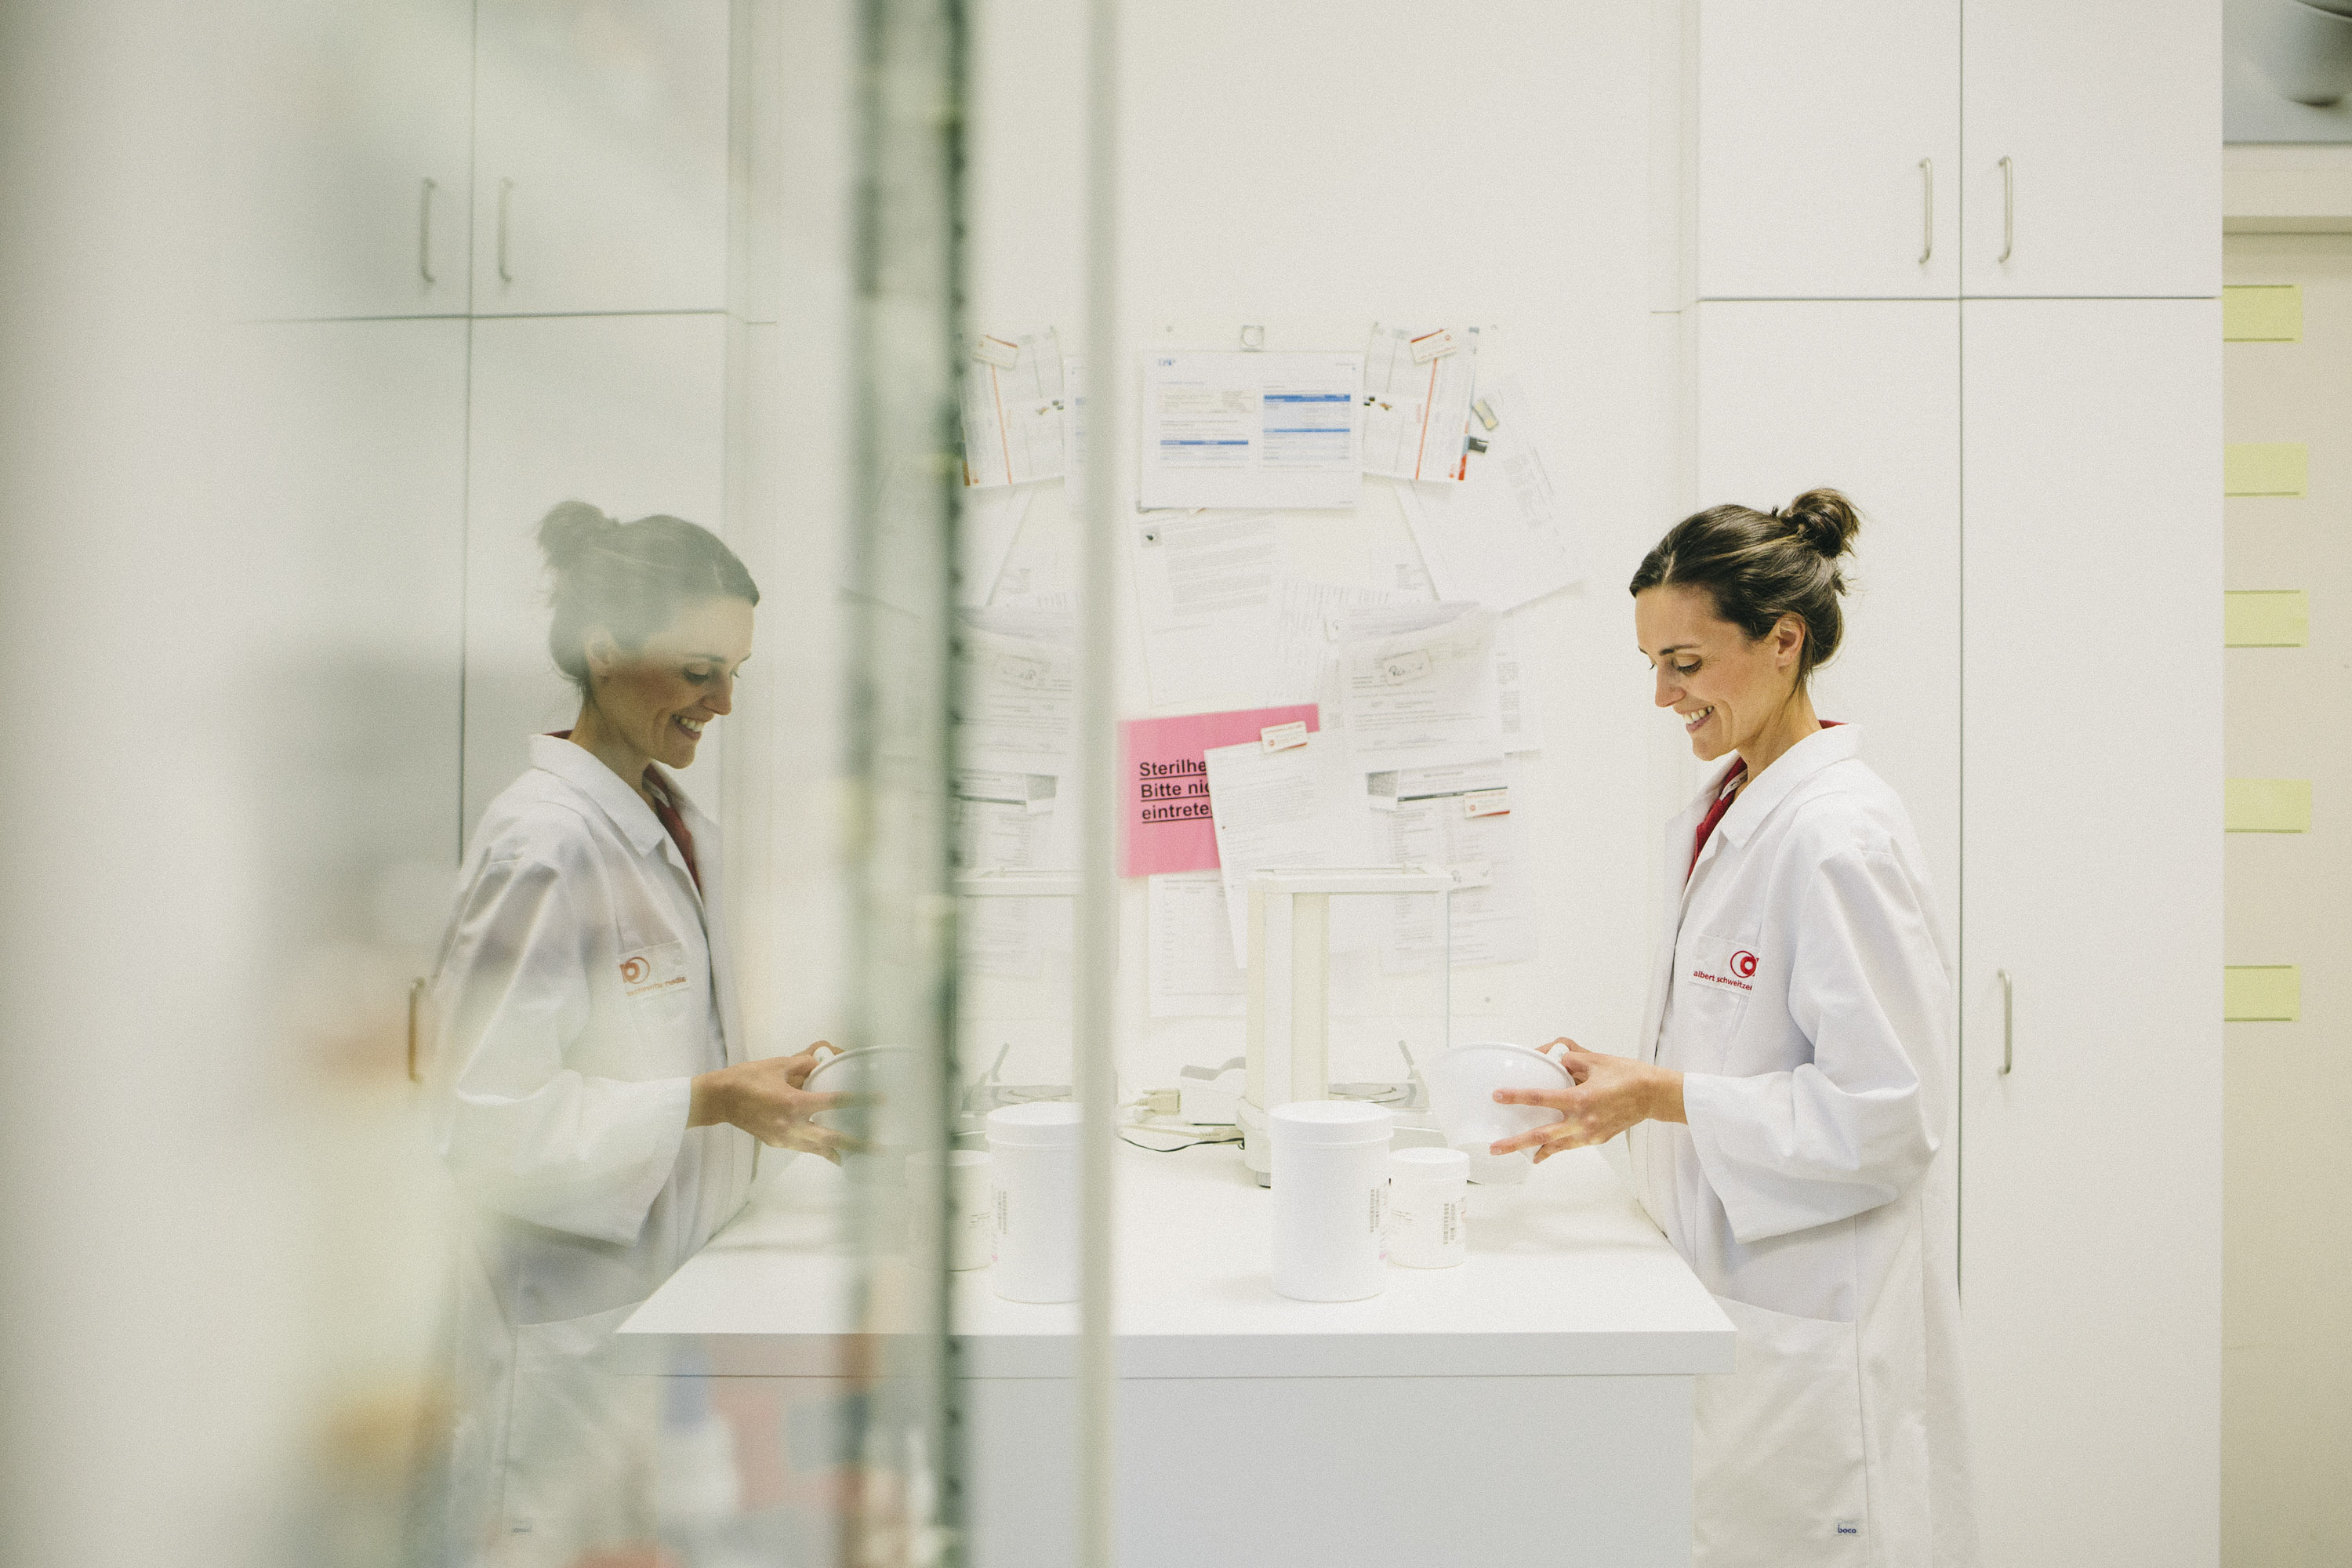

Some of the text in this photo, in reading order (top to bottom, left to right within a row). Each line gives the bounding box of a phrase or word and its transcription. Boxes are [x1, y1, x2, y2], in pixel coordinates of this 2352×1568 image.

[1139, 759, 1207, 775] Sterilhe
[1141, 783, 1181, 798] Bitte
[1142, 803, 1212, 819] eintrete
[1693, 971, 1715, 982] albert
[1837, 1523, 1857, 1534] boco
